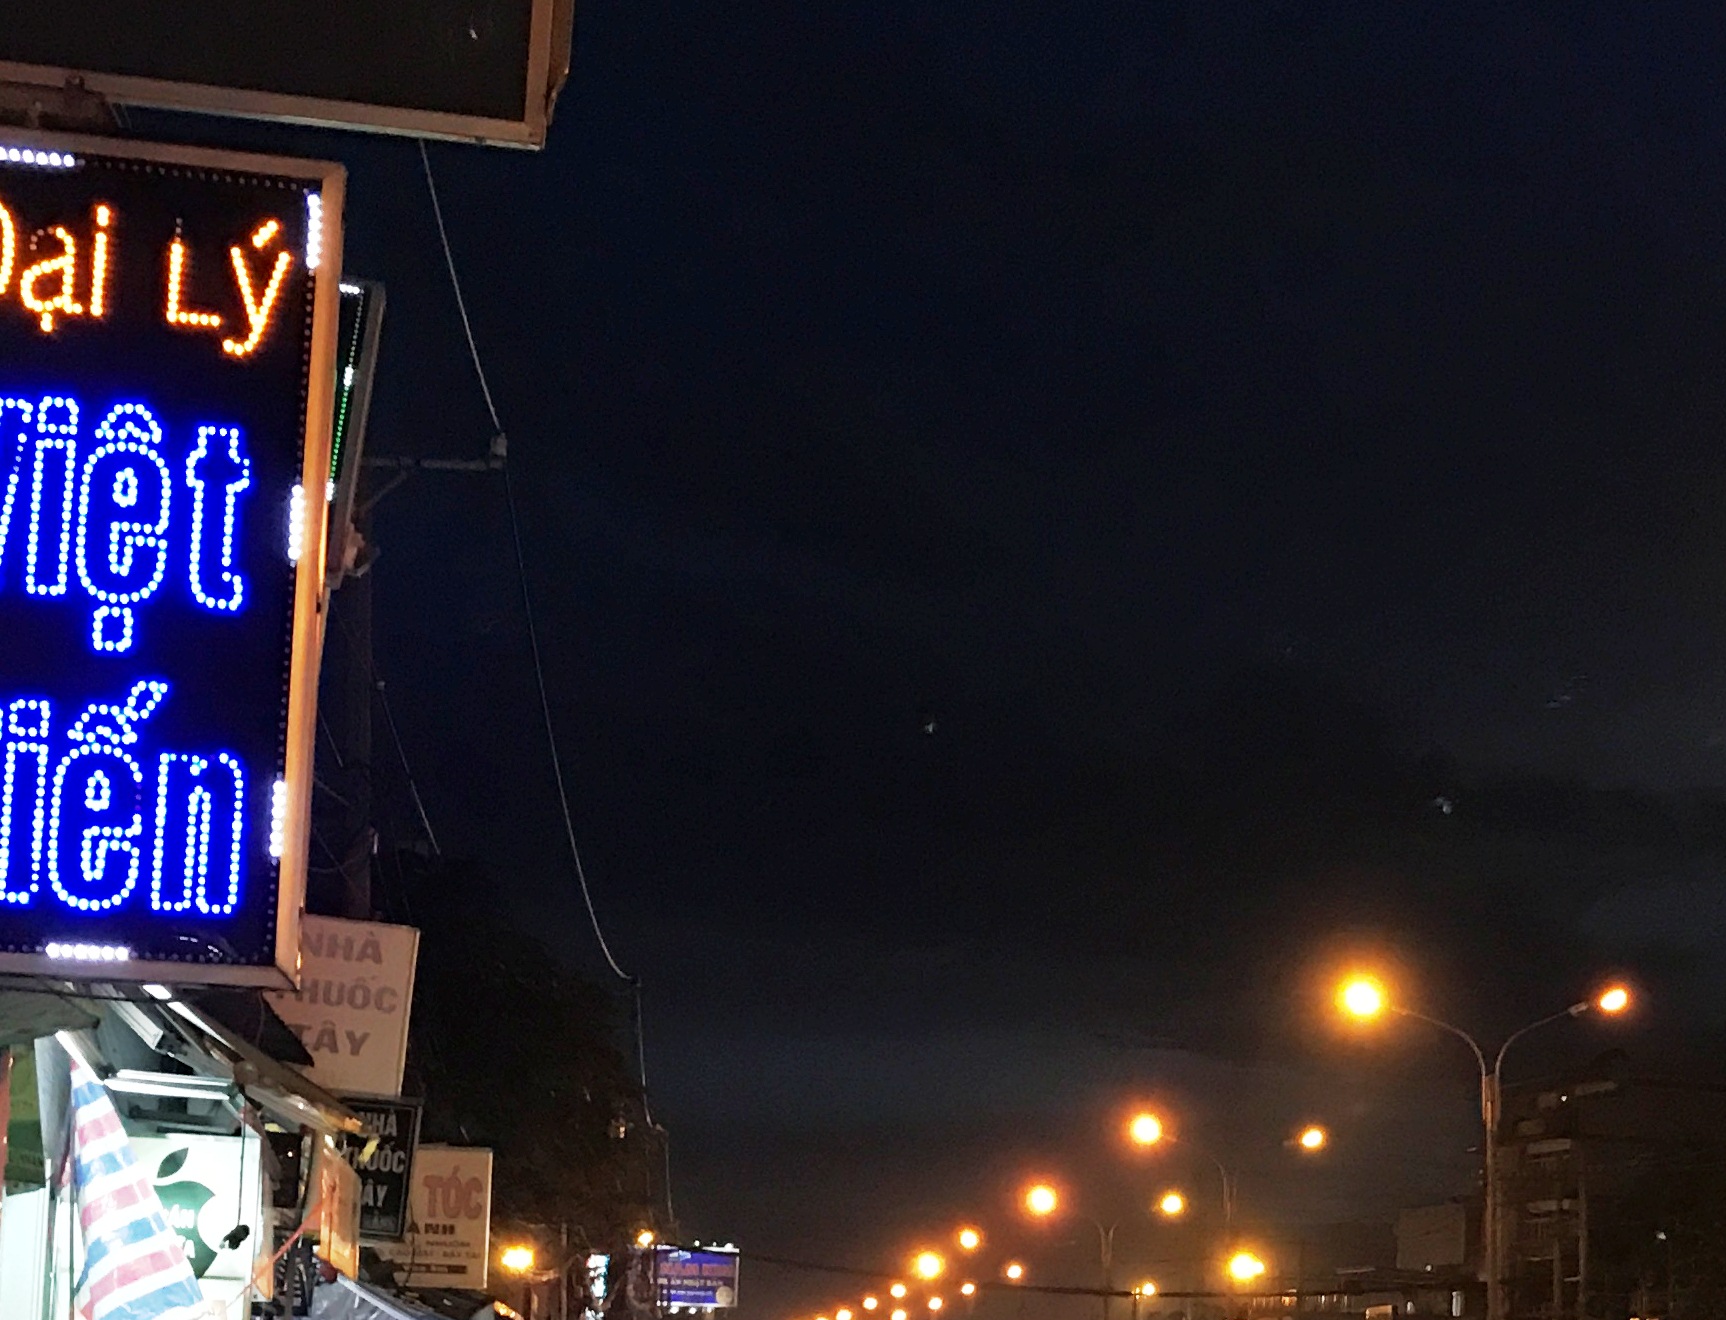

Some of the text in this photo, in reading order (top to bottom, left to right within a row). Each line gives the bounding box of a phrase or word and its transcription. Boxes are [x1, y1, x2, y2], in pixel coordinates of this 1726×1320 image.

[166, 217, 292, 356] Lý
[0, 680, 243, 915] iến
[275, 976, 399, 1015] HUỐC
[422, 1164, 483, 1219] TÓC
